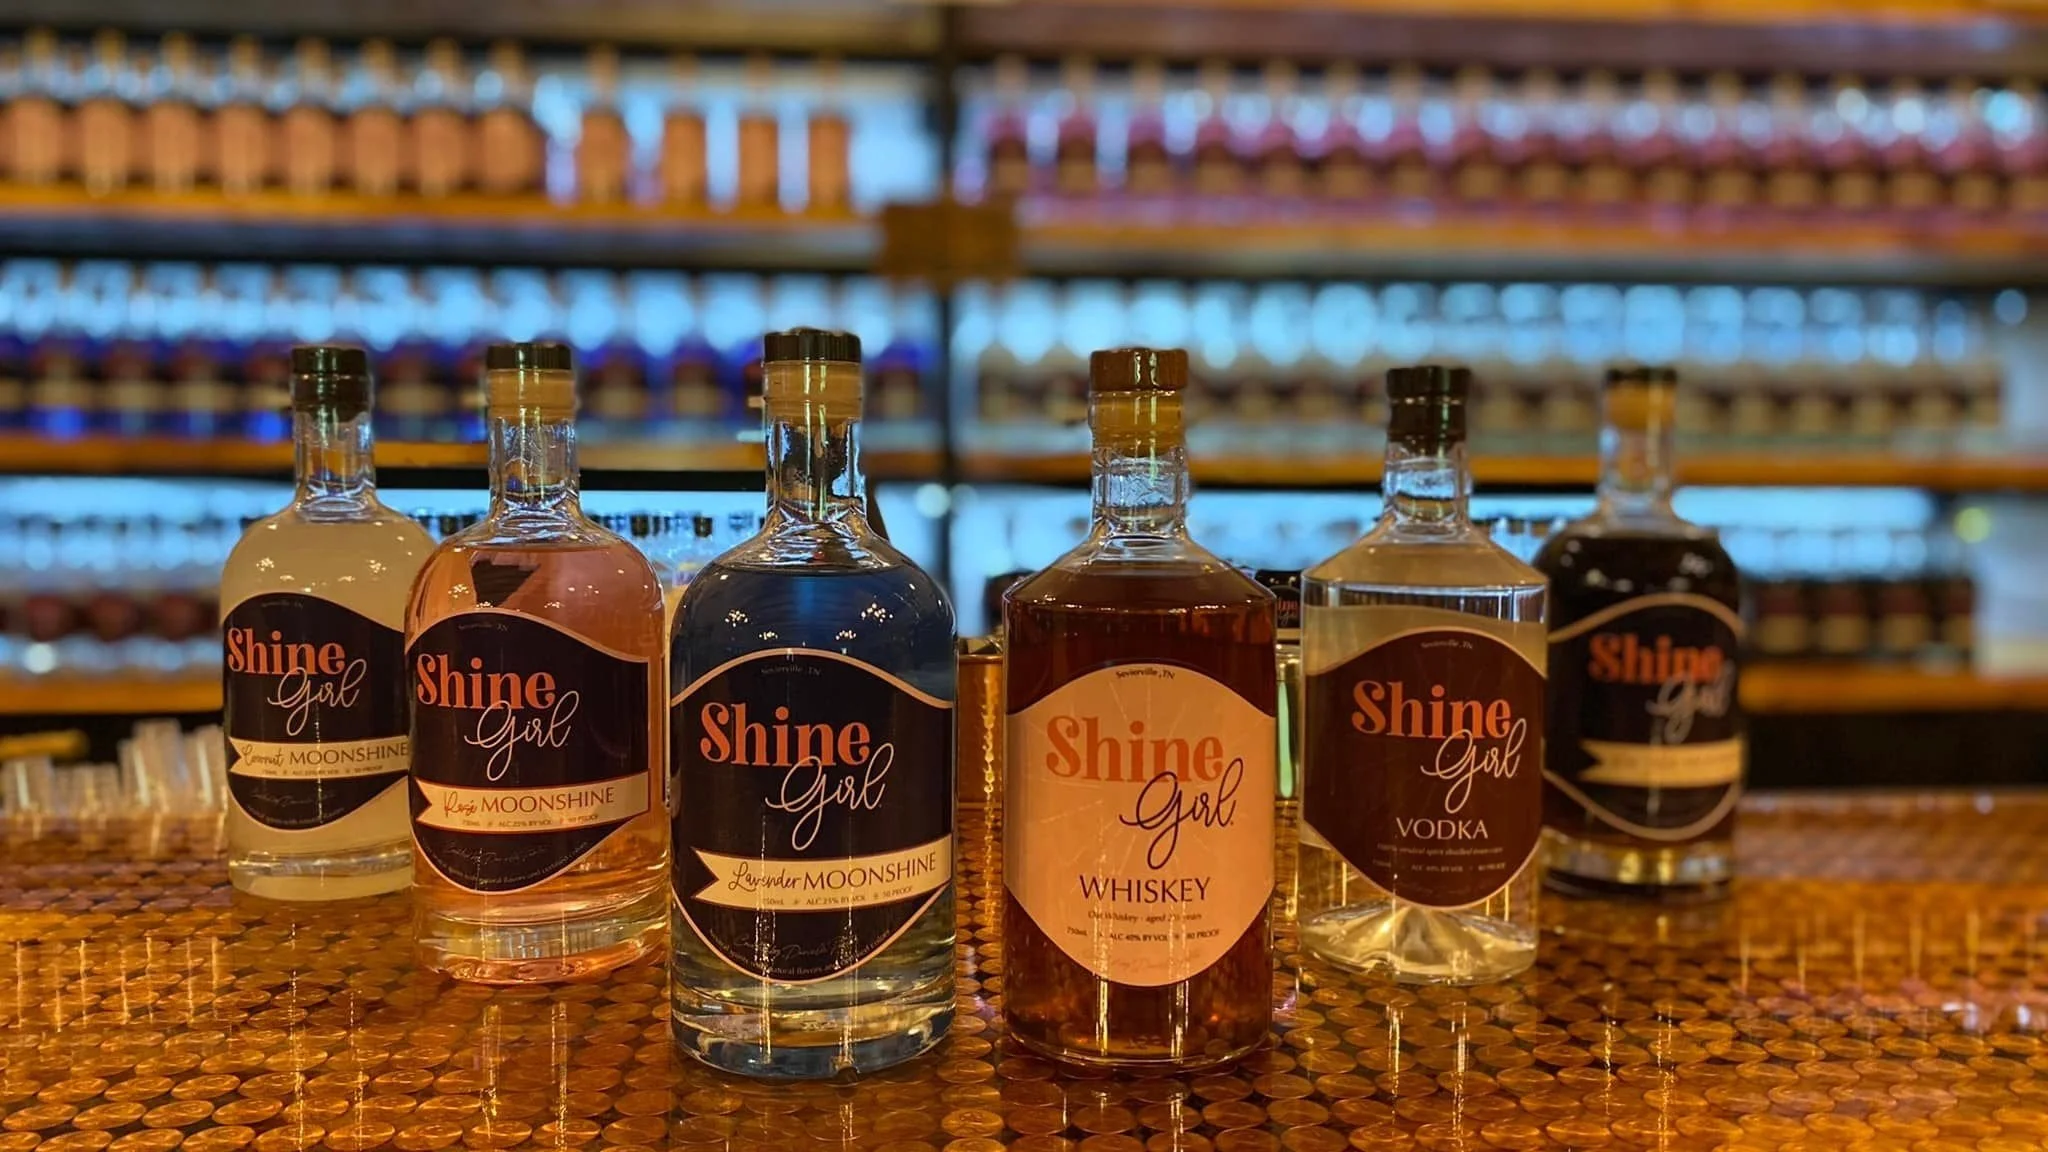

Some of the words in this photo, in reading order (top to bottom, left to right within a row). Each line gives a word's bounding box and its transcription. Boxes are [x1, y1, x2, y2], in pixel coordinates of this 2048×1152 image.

[227, 627, 346, 675] Shine
[1588, 632, 1724, 685] Shine
[267, 659, 367, 737] Girl
[416, 653, 556, 709] Shine
[1352, 680, 1511, 738] Shine
[289, 742, 408, 765] MOONSHINE
[464, 690, 580, 781] Girl
[700, 702, 870, 766] Shine
[1046, 715, 1224, 783] Shine
[1420, 718, 1527, 814] Girl
[481, 787, 615, 813] MOONSHINE
[765, 743, 894, 850] Girl
[1119, 758, 1243, 870] Girl
[1396, 817, 1489, 840] VODKA
[728, 861, 802, 892] Lavender
[803, 852, 936, 890] MOONSHINE
[1079, 874, 1211, 904] WHISKEY
